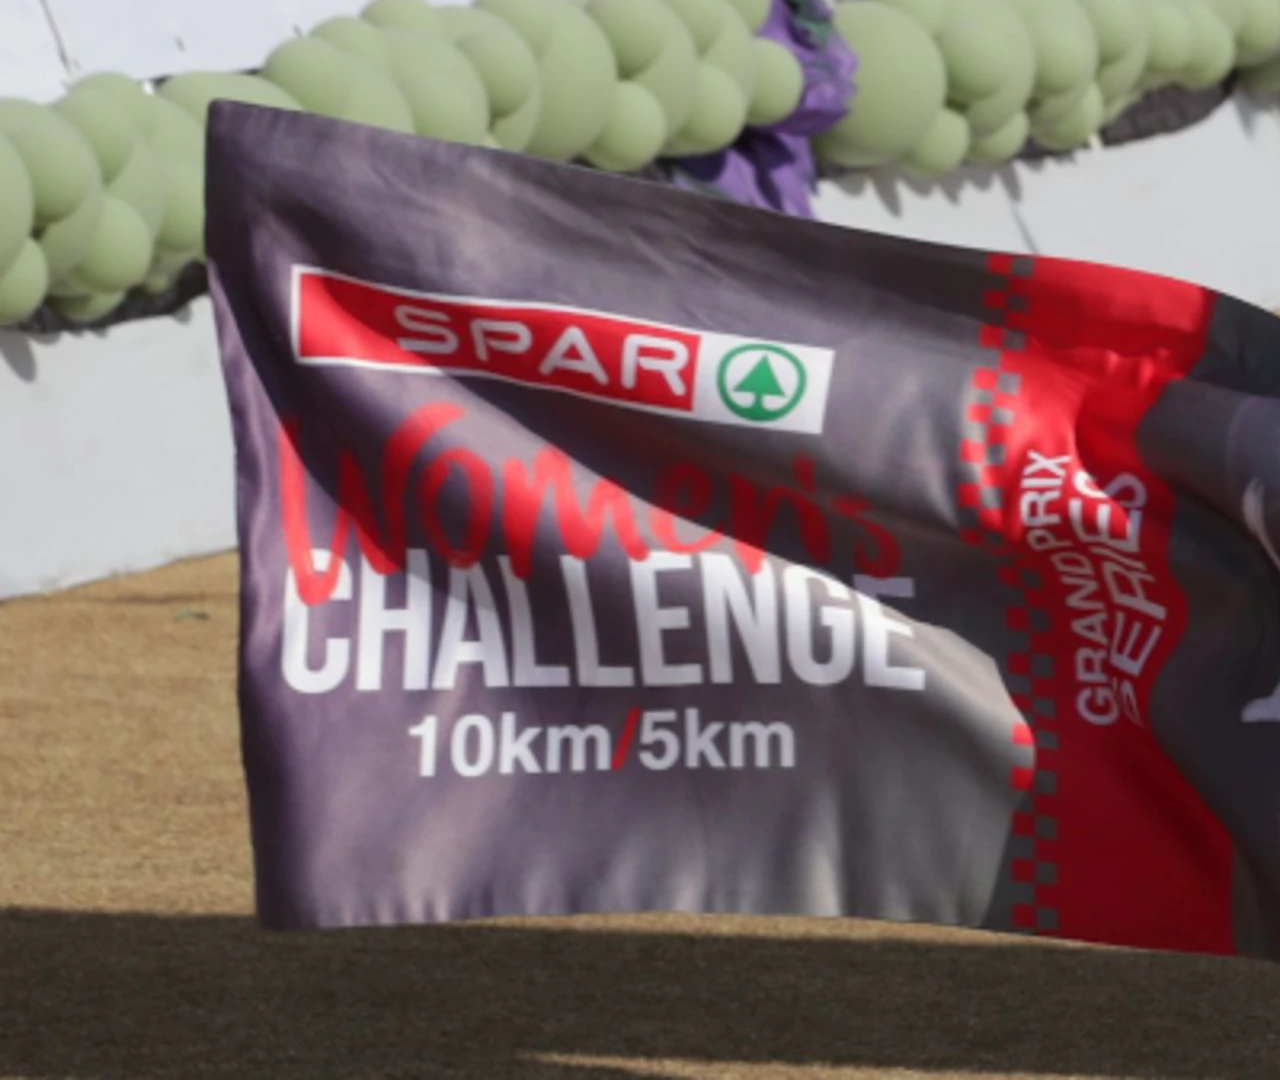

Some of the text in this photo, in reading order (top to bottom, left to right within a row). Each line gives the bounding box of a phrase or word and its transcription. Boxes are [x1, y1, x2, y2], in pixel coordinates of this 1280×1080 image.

[393, 304, 688, 396] SPAR
[276, 402, 904, 608] Women's
[281, 546, 927, 694] CHALLENGE
[1020, 449, 1120, 726] GRAND PRIX
[407, 706, 796, 778] 10km/5km
